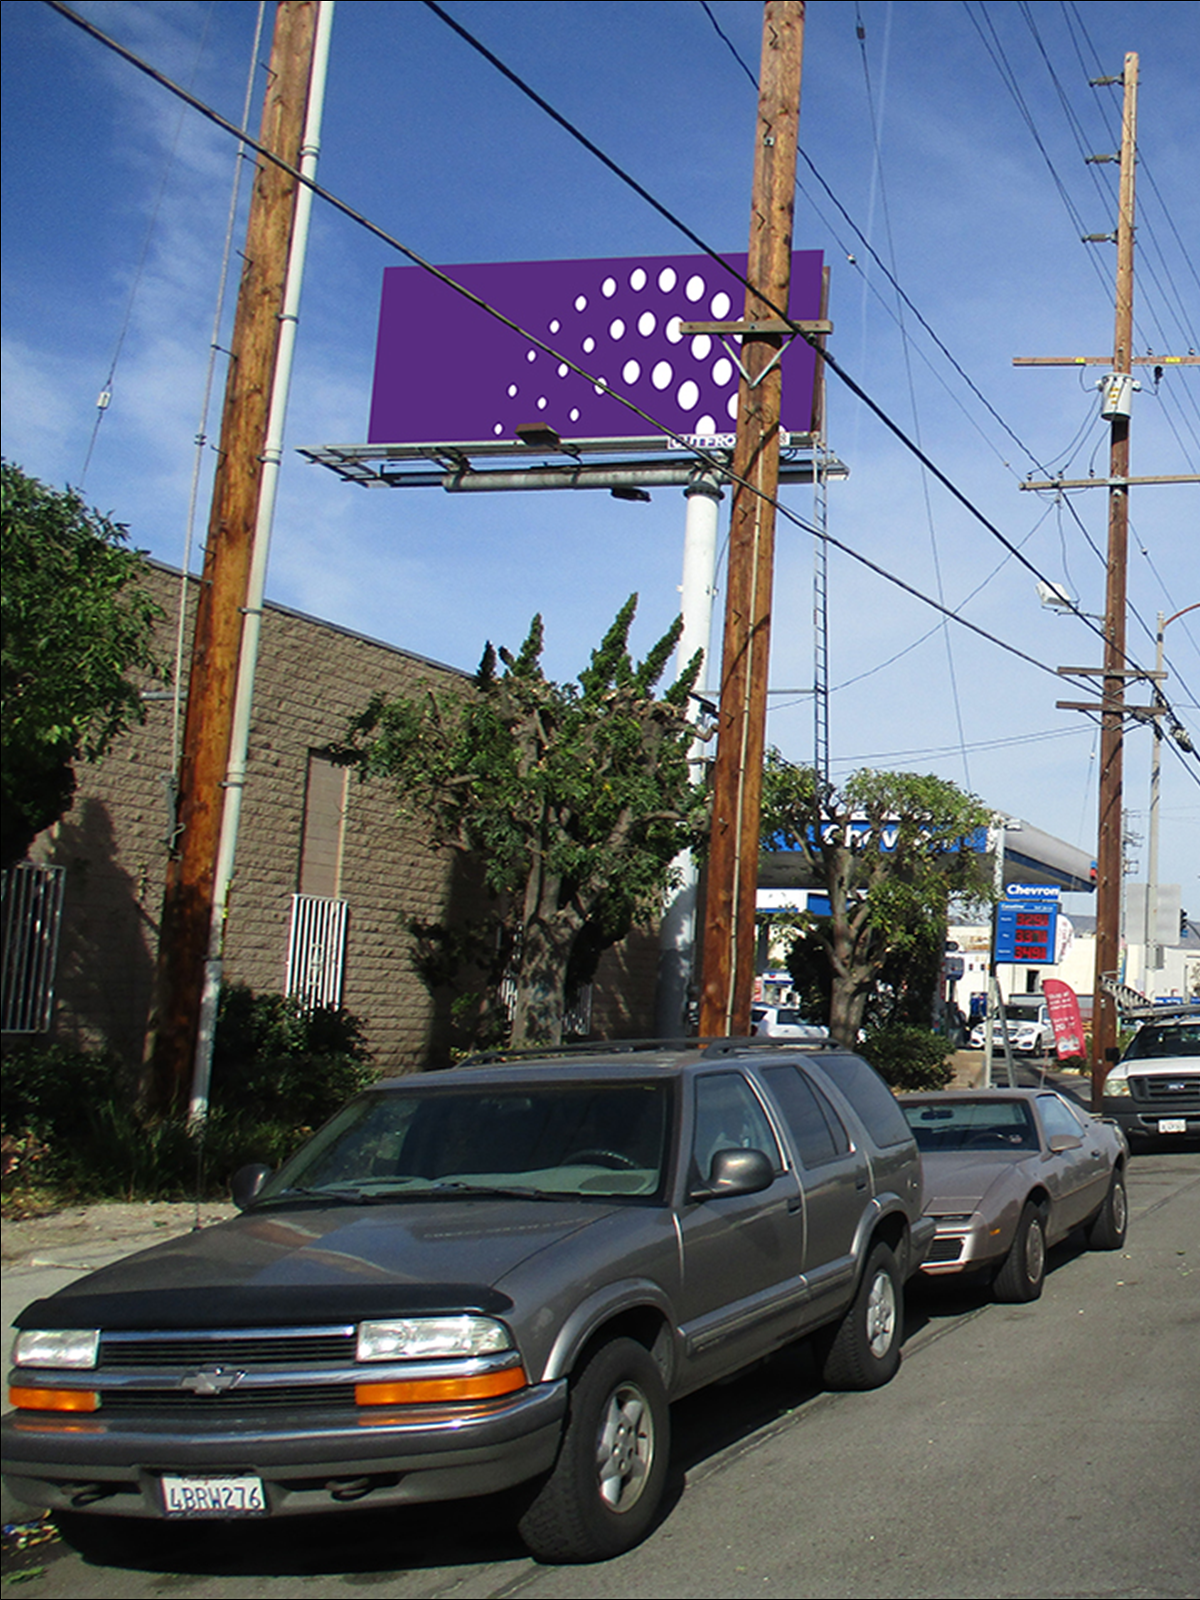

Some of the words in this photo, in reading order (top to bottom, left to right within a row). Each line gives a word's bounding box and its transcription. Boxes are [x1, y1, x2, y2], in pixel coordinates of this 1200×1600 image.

[668, 433, 738, 450] OUTFRO
[1006, 884, 1059, 896] Chevron
[170, 1486, 262, 1510] 4BRW276
